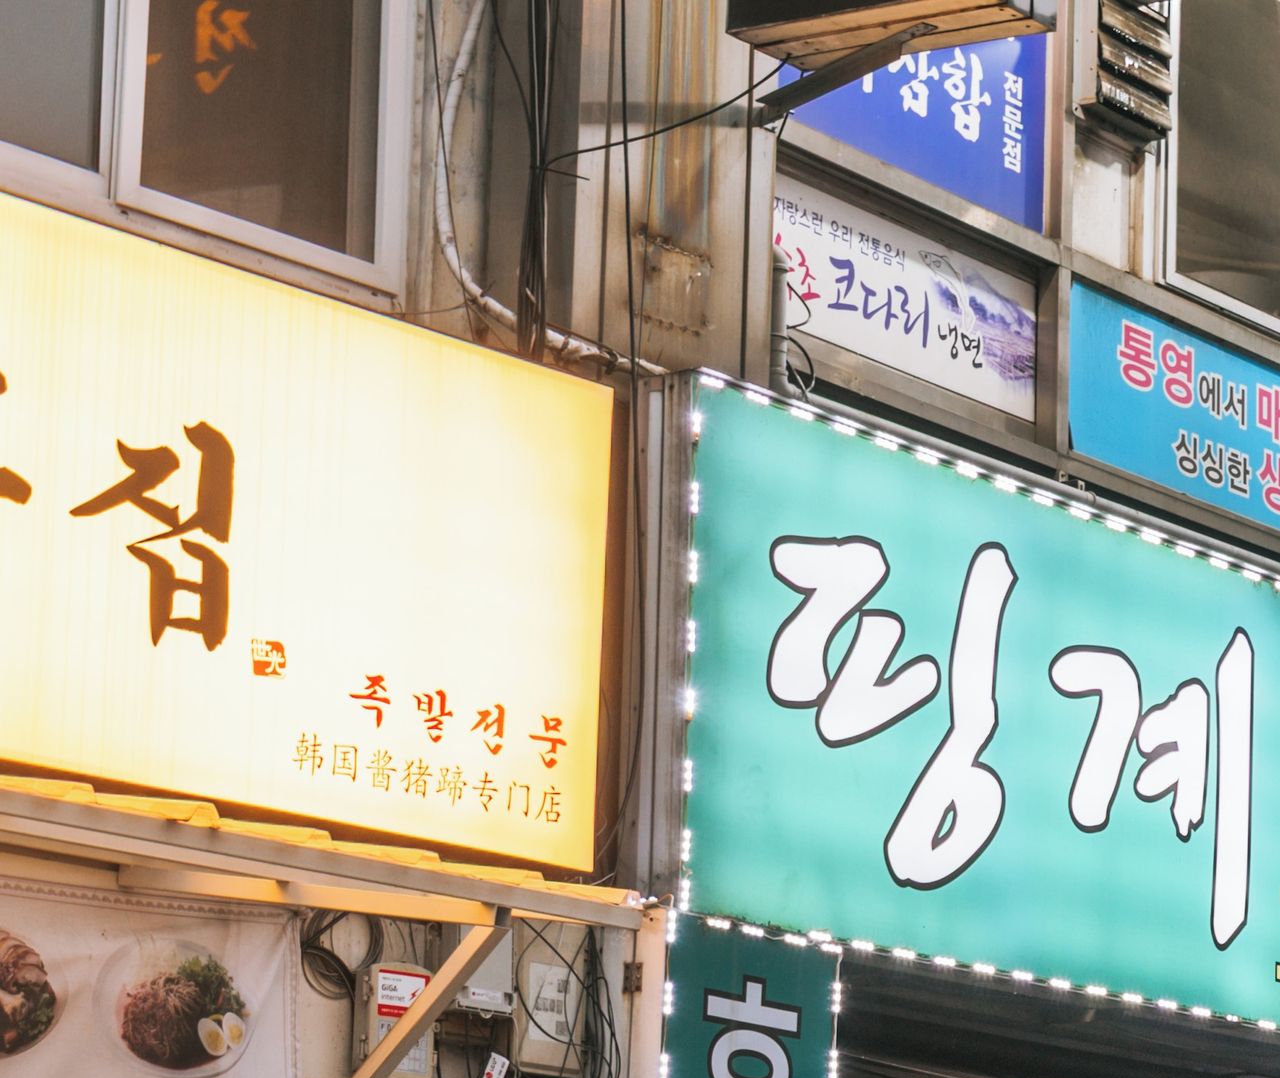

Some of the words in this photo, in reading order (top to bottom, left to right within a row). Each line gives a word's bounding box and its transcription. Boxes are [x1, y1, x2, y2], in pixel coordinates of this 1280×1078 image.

[1002, 71, 1024, 173] 전문점
[828, 219, 853, 249] 우리
[858, 231, 906, 271] 전통음식
[828, 255, 930, 348] 코다리
[938, 322, 983, 369] 냉면
[1117, 319, 1248, 430] 통영에서
[1174, 429, 1250, 499] 싱싱한
[291, 733, 563, 823] 韩国酱猪蹄专门店
